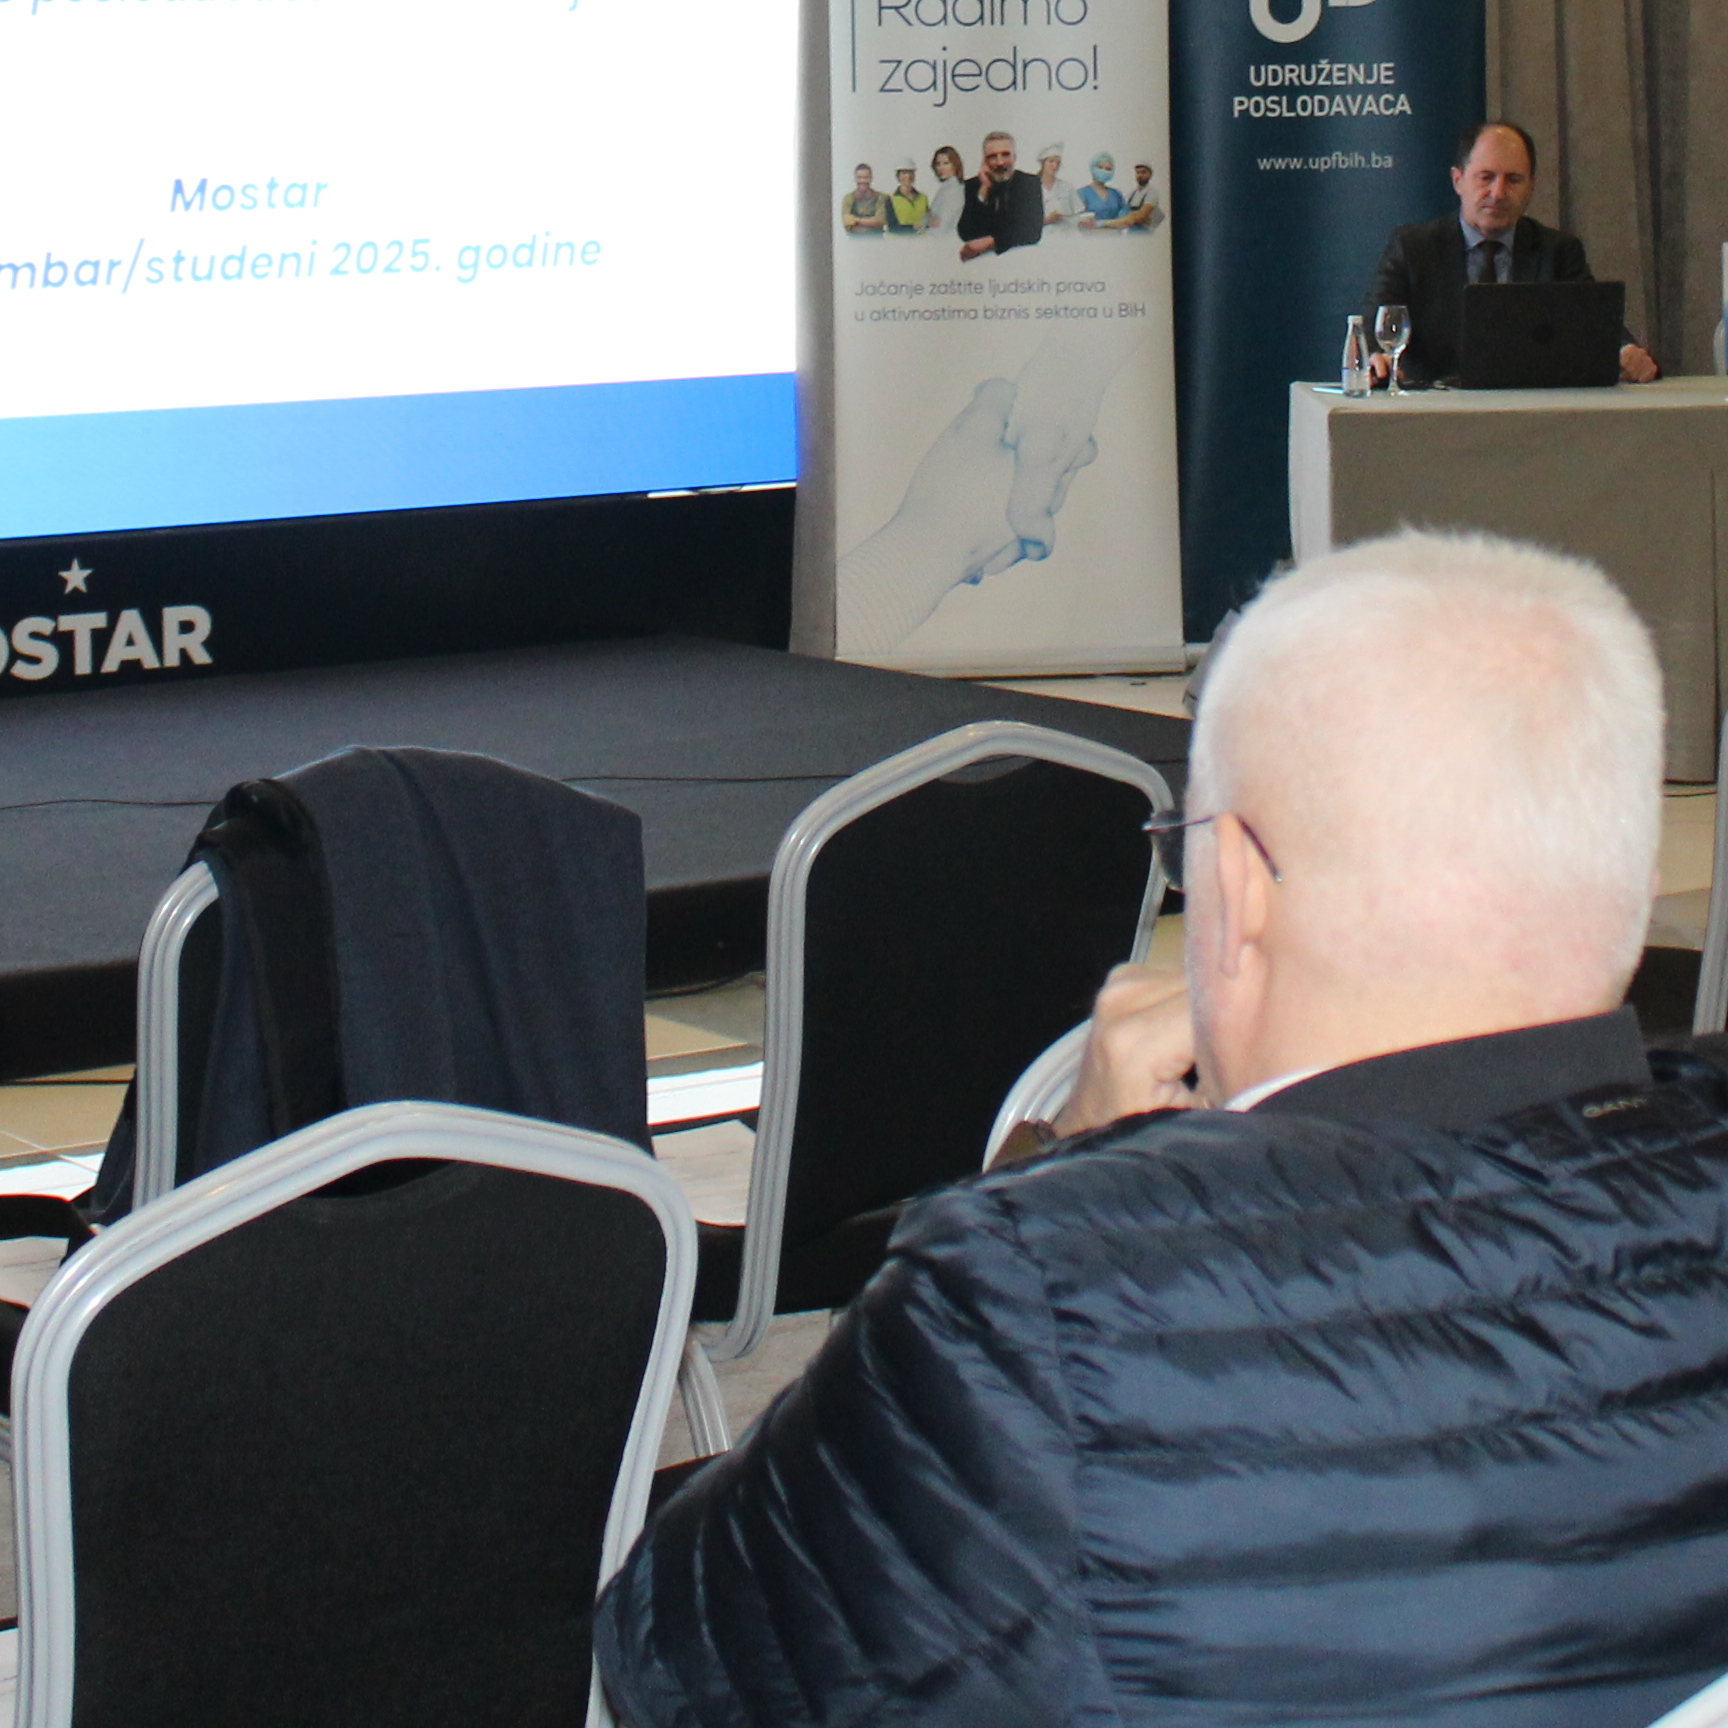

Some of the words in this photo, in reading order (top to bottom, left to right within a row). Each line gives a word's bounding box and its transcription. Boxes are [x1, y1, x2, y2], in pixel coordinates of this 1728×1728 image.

[878, 43, 1099, 108] zajedno!
[1249, 58, 1395, 87] UDRUŽENJE
[1233, 93, 1412, 118] POSLODAVACA
[1257, 151, 1394, 172] www.upfbih.ba
[170, 177, 328, 213] Mostar
[329, 238, 441, 276] 2025.
[457, 231, 602, 284] godine
[855, 281, 925, 300] Jačanje
[929, 279, 984, 296] zaštite
[988, 278, 1051, 298] ljudskih
[1056, 282, 1106, 296] prava
[855, 311, 865, 322] u
[870, 306, 978, 322] aktivnostima
[984, 304, 1030, 320] biznis
[1035, 304, 1098, 320] sektora
[1103, 307, 1113, 319] u
[1118, 302, 1145, 318] BiH
